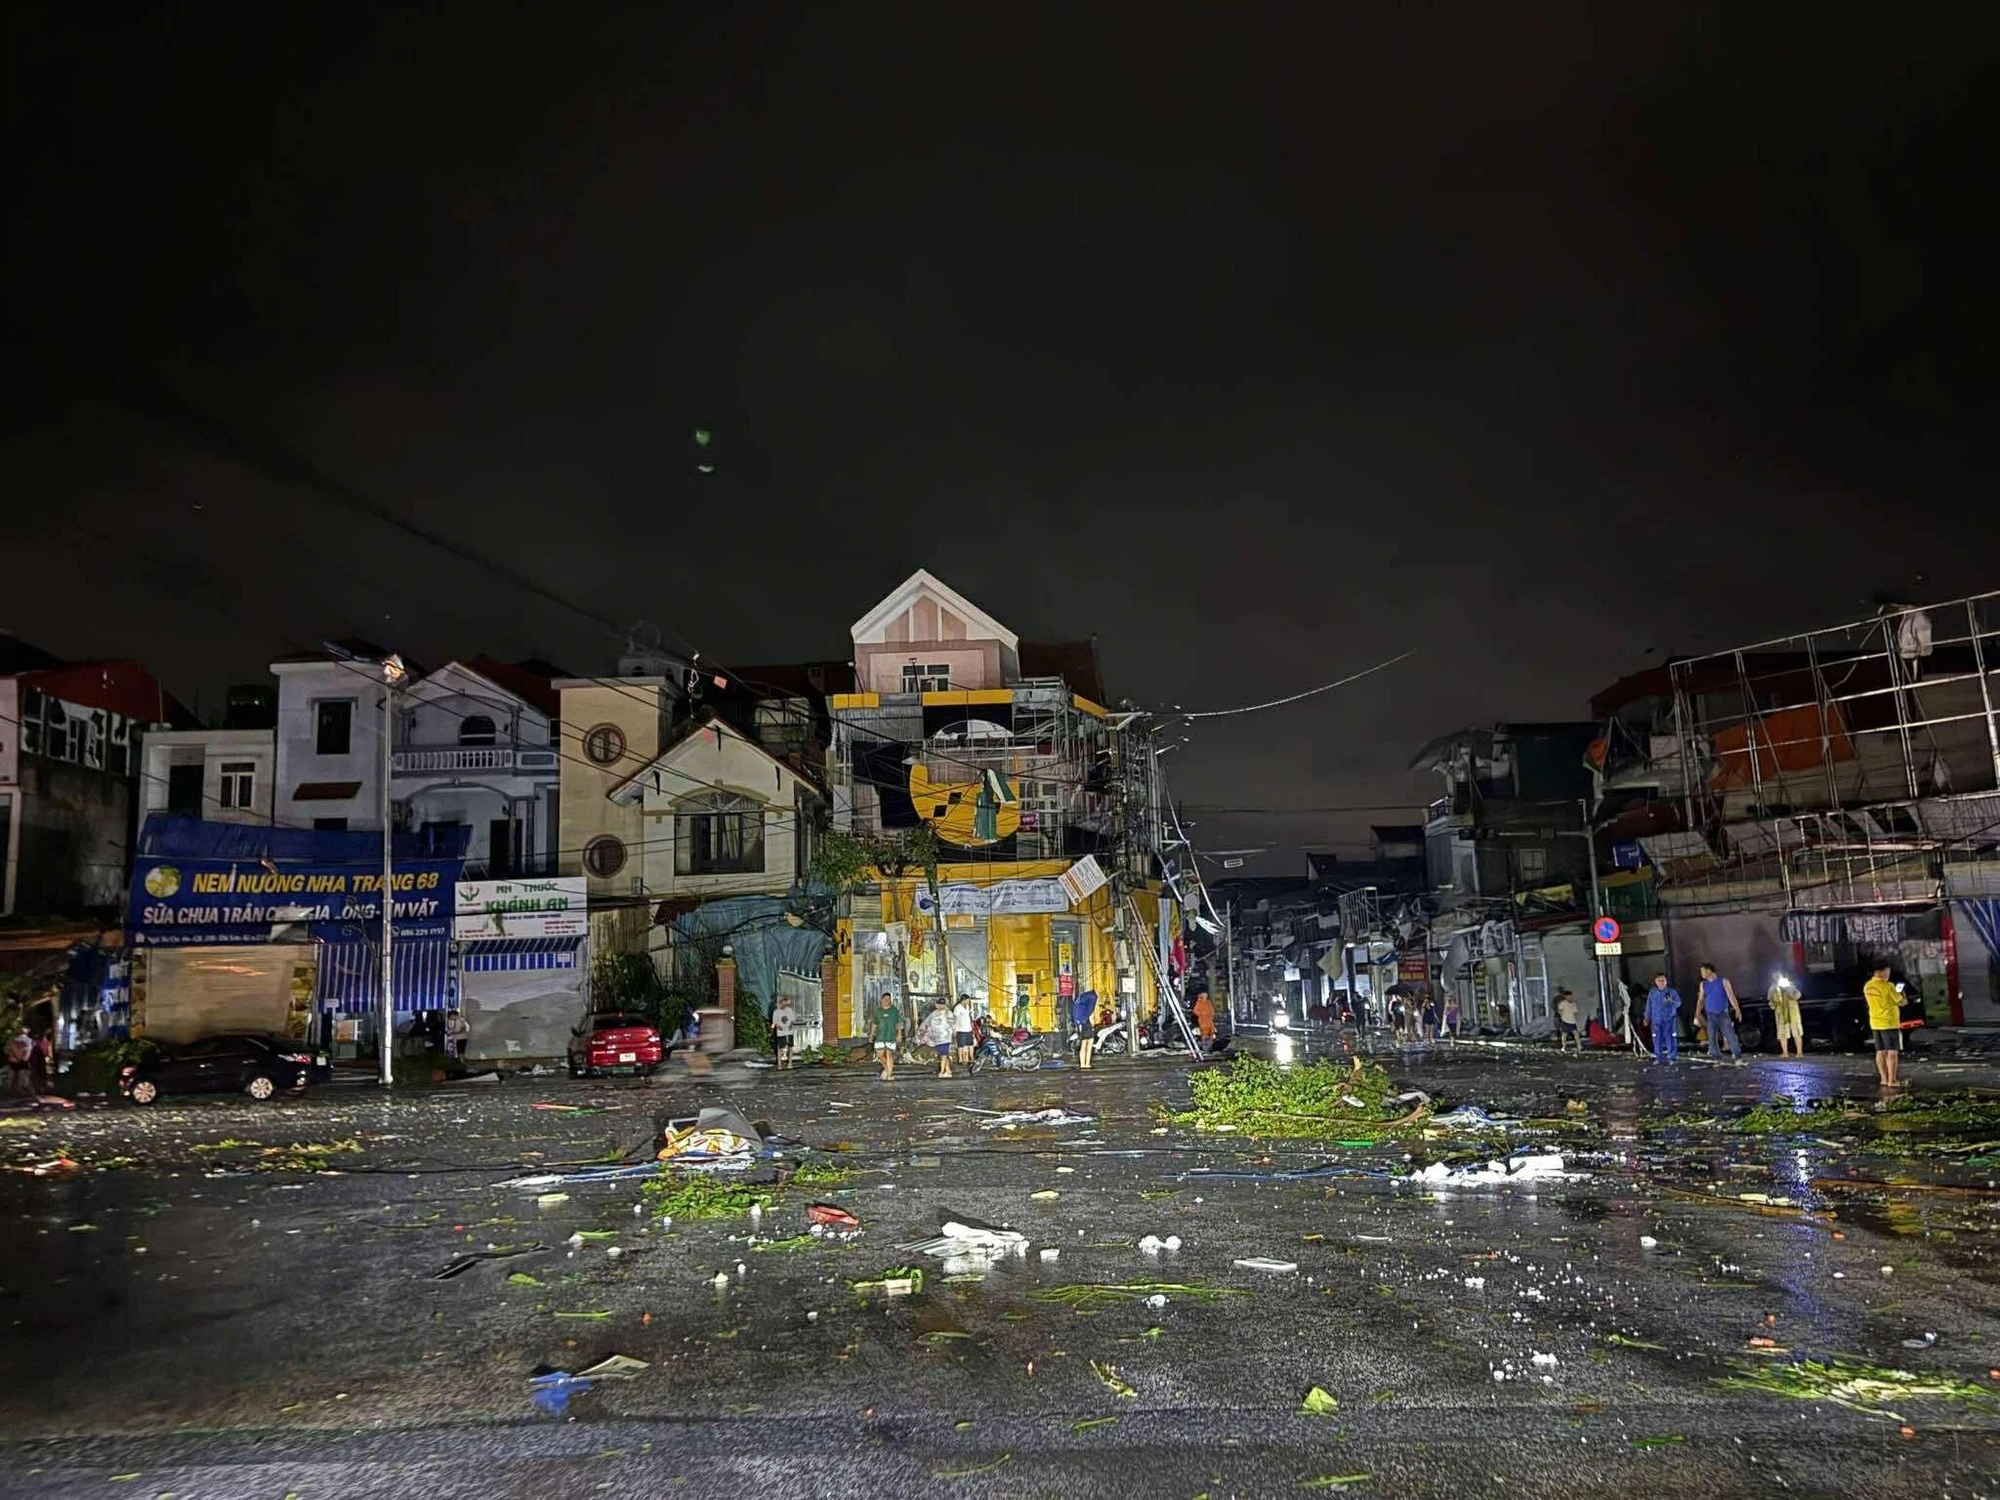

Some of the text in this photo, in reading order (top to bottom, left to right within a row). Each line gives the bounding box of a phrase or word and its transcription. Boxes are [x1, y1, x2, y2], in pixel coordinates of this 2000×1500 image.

[193, 873, 234, 893] NEM
[306, 875, 346, 893] NHA
[352, 873, 415, 892] TRANG
[416, 872, 439, 889] 68
[485, 896, 569, 912] KHÁNH AN
